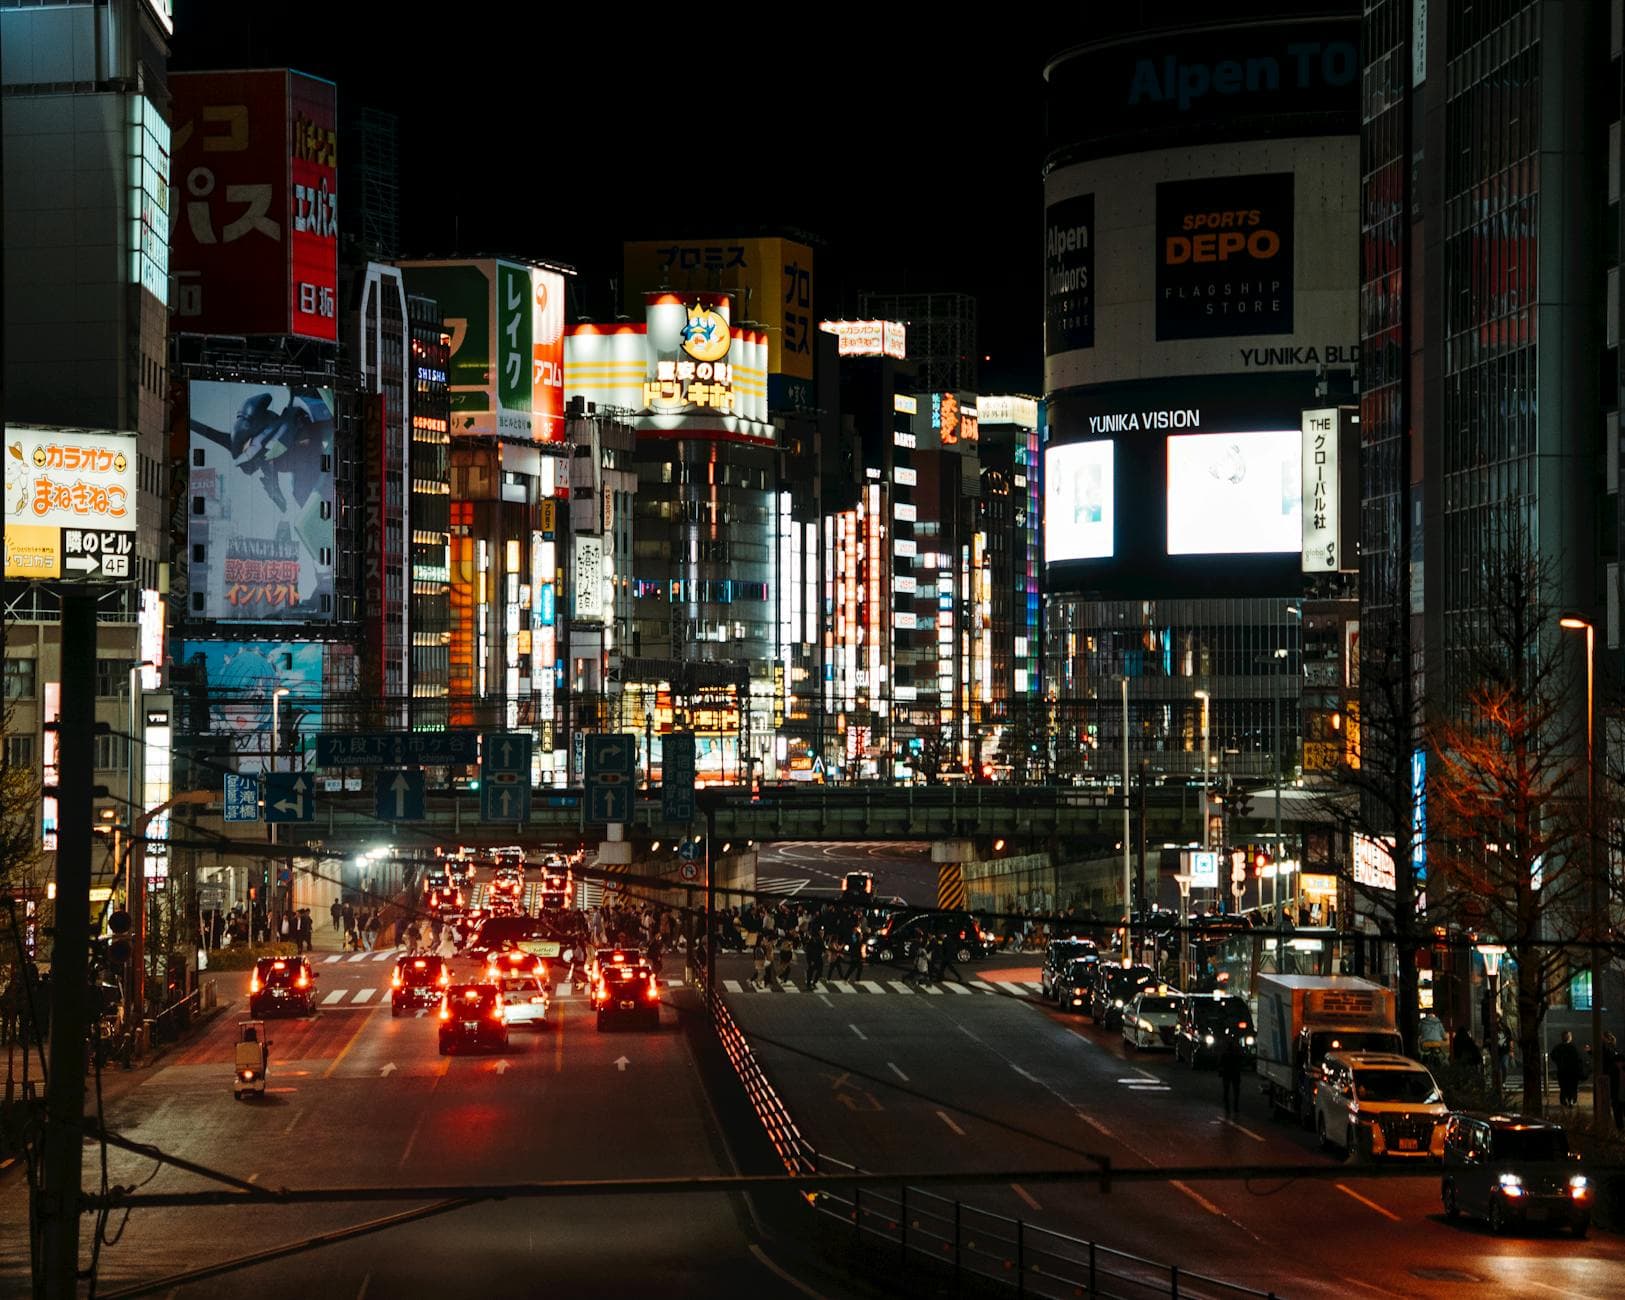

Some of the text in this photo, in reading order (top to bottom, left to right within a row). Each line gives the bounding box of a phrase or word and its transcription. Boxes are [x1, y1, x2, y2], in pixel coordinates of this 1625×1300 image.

[1127, 55, 1281, 112] Alpen
[294, 178, 337, 239] エスパス
[1183, 209, 1262, 231] SPORTS
[1048, 225, 1088, 264] Alpen
[1166, 229, 1281, 265] DEPO
[657, 247, 747, 270] プロミス
[300, 282, 335, 318] 日拓
[1165, 281, 1280, 299] FLAGSHIP
[1206, 301, 1280, 315] STORE
[506, 274, 522, 390] レイク
[1240, 346, 1320, 367] YUNIKA
[418, 367, 446, 383] SHISHA
[534, 360, 562, 388] アコム
[1089, 409, 1200, 434] YUNIKA VISION
[46, 445, 114, 472] カラオケ
[1310, 418, 1331, 530] THE グローバル社
[33, 474, 127, 516] まねきねこ
[65, 531, 132, 554] 隣のビル
[13, 554, 55, 568] ワンカラ
[105, 559, 125, 573] 4F
[225, 559, 300, 583] 歌舞伎町
[225, 583, 300, 607] インパクト
[329, 737, 388, 754] 九段下
[240, 778, 257, 819] 小滝橋
